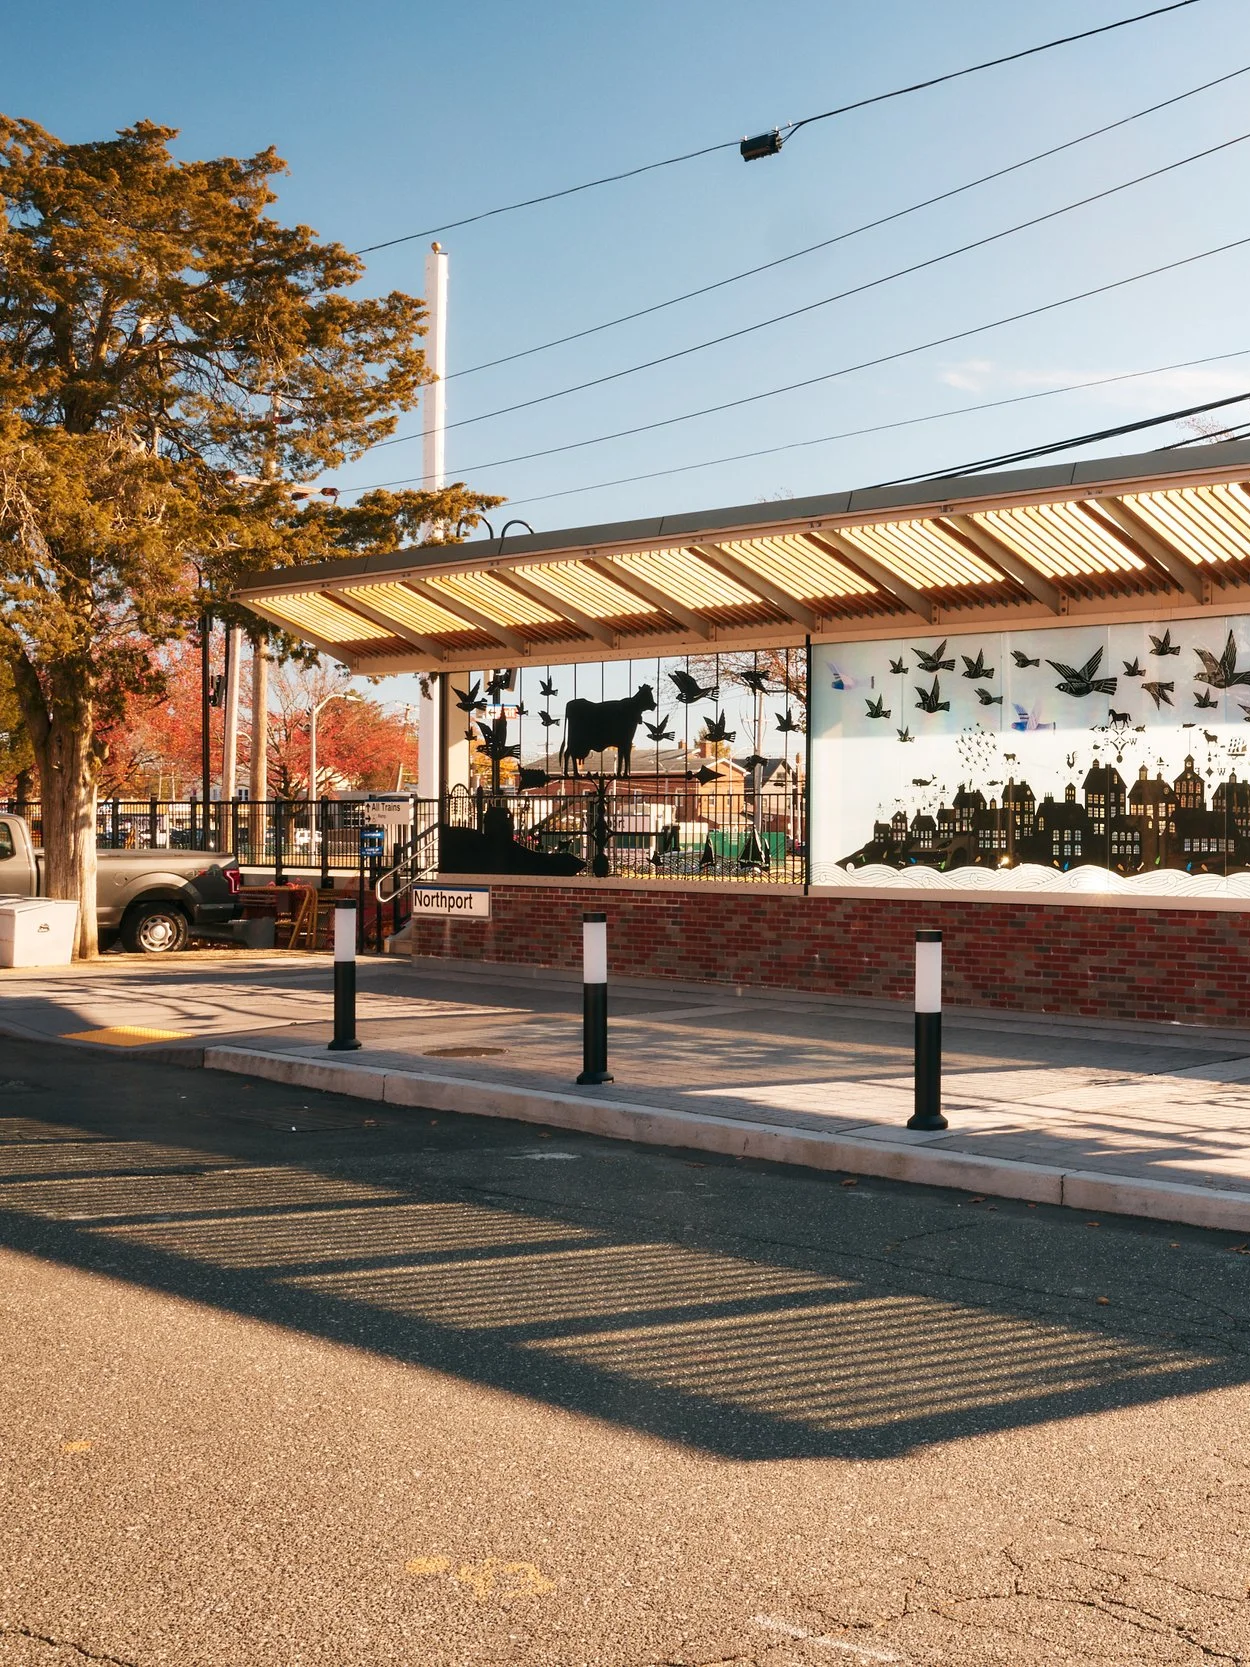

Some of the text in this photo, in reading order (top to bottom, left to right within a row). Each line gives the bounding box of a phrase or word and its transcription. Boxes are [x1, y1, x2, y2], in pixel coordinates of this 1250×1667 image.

[371, 803, 401, 812] All Trains
[414, 890, 473, 912] Northport
